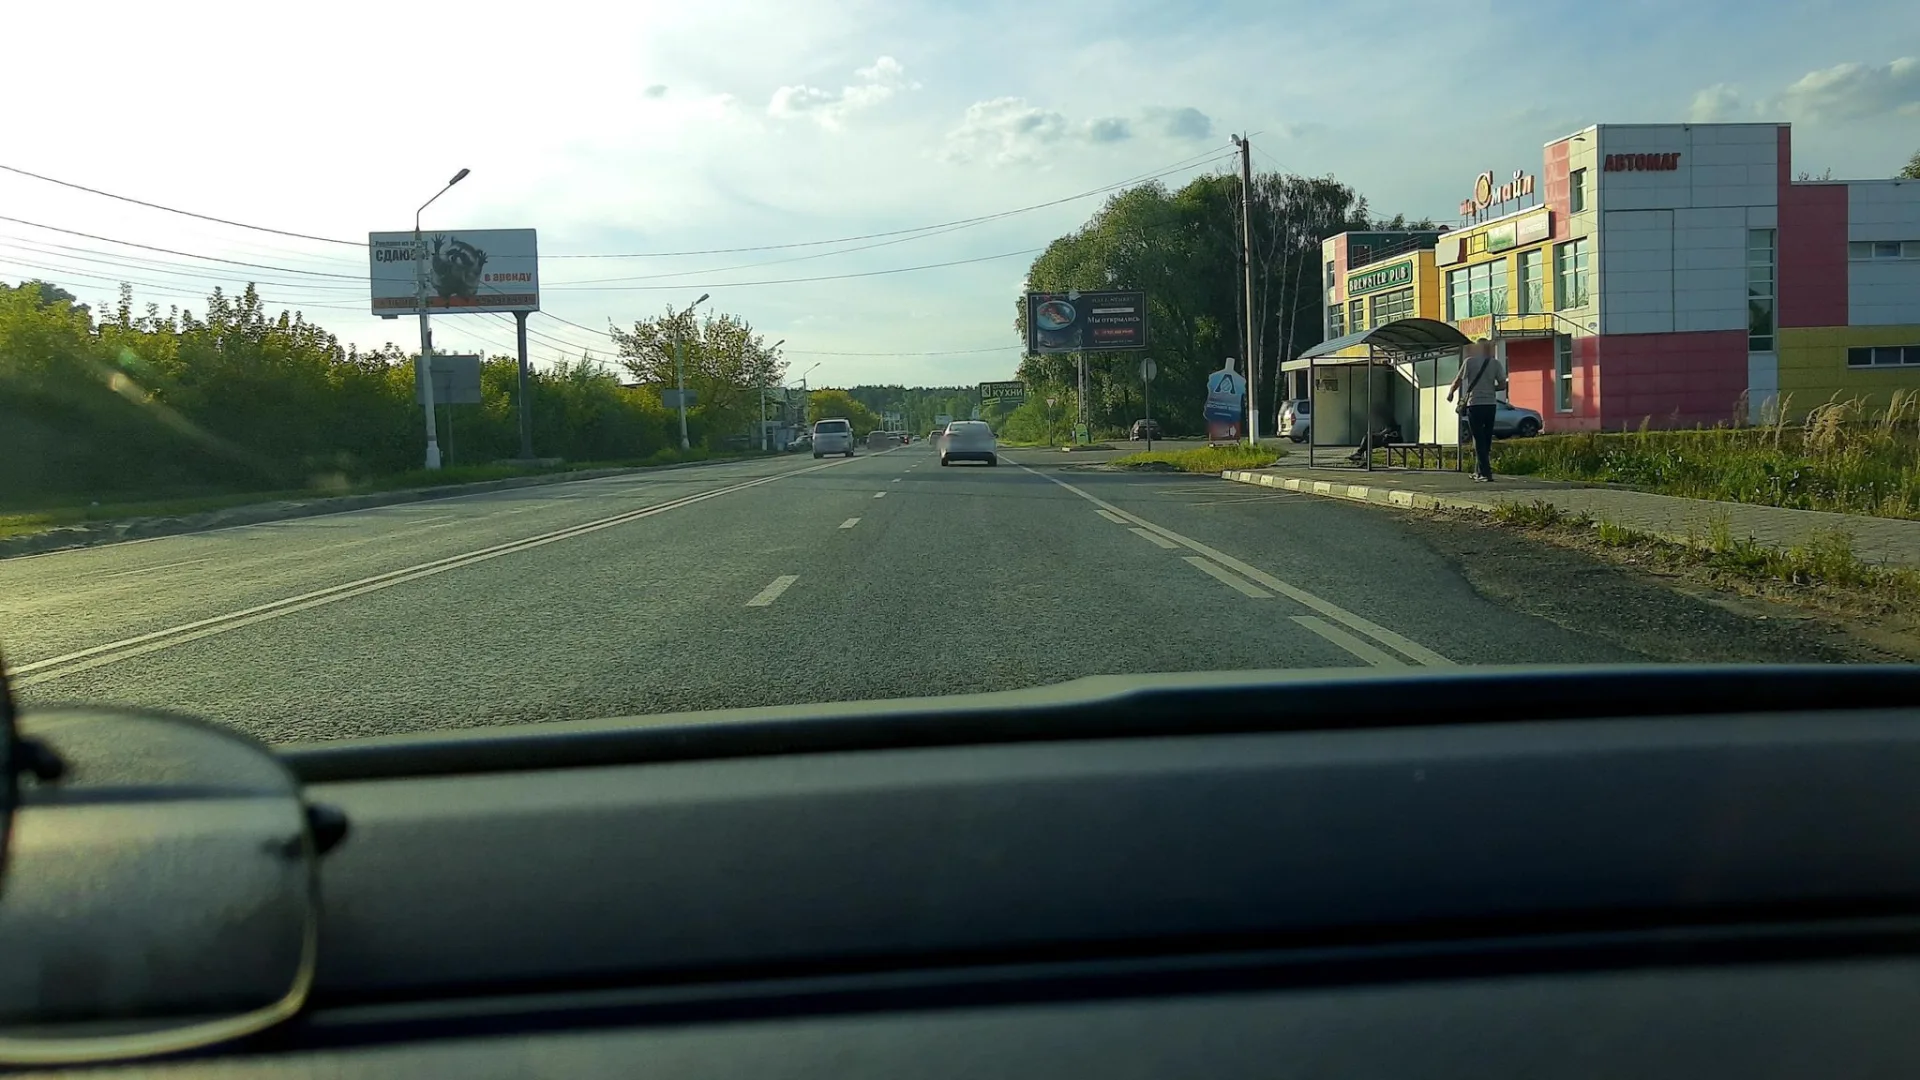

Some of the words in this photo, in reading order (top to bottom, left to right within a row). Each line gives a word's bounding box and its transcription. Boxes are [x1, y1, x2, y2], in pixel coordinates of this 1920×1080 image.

[1604, 152, 1681, 172] АВТОМАГ
[1475, 169, 1535, 209] Смайл
[376, 249, 429, 262] СДАЮС!
[493, 272, 532, 283] аренду
[1349, 271, 1389, 292] BREWSTER
[1389, 267, 1408, 282] PUB
[1087, 316, 1100, 324] Мы
[1102, 316, 1140, 324] открылись
[992, 388, 1023, 397] КУХНИ
